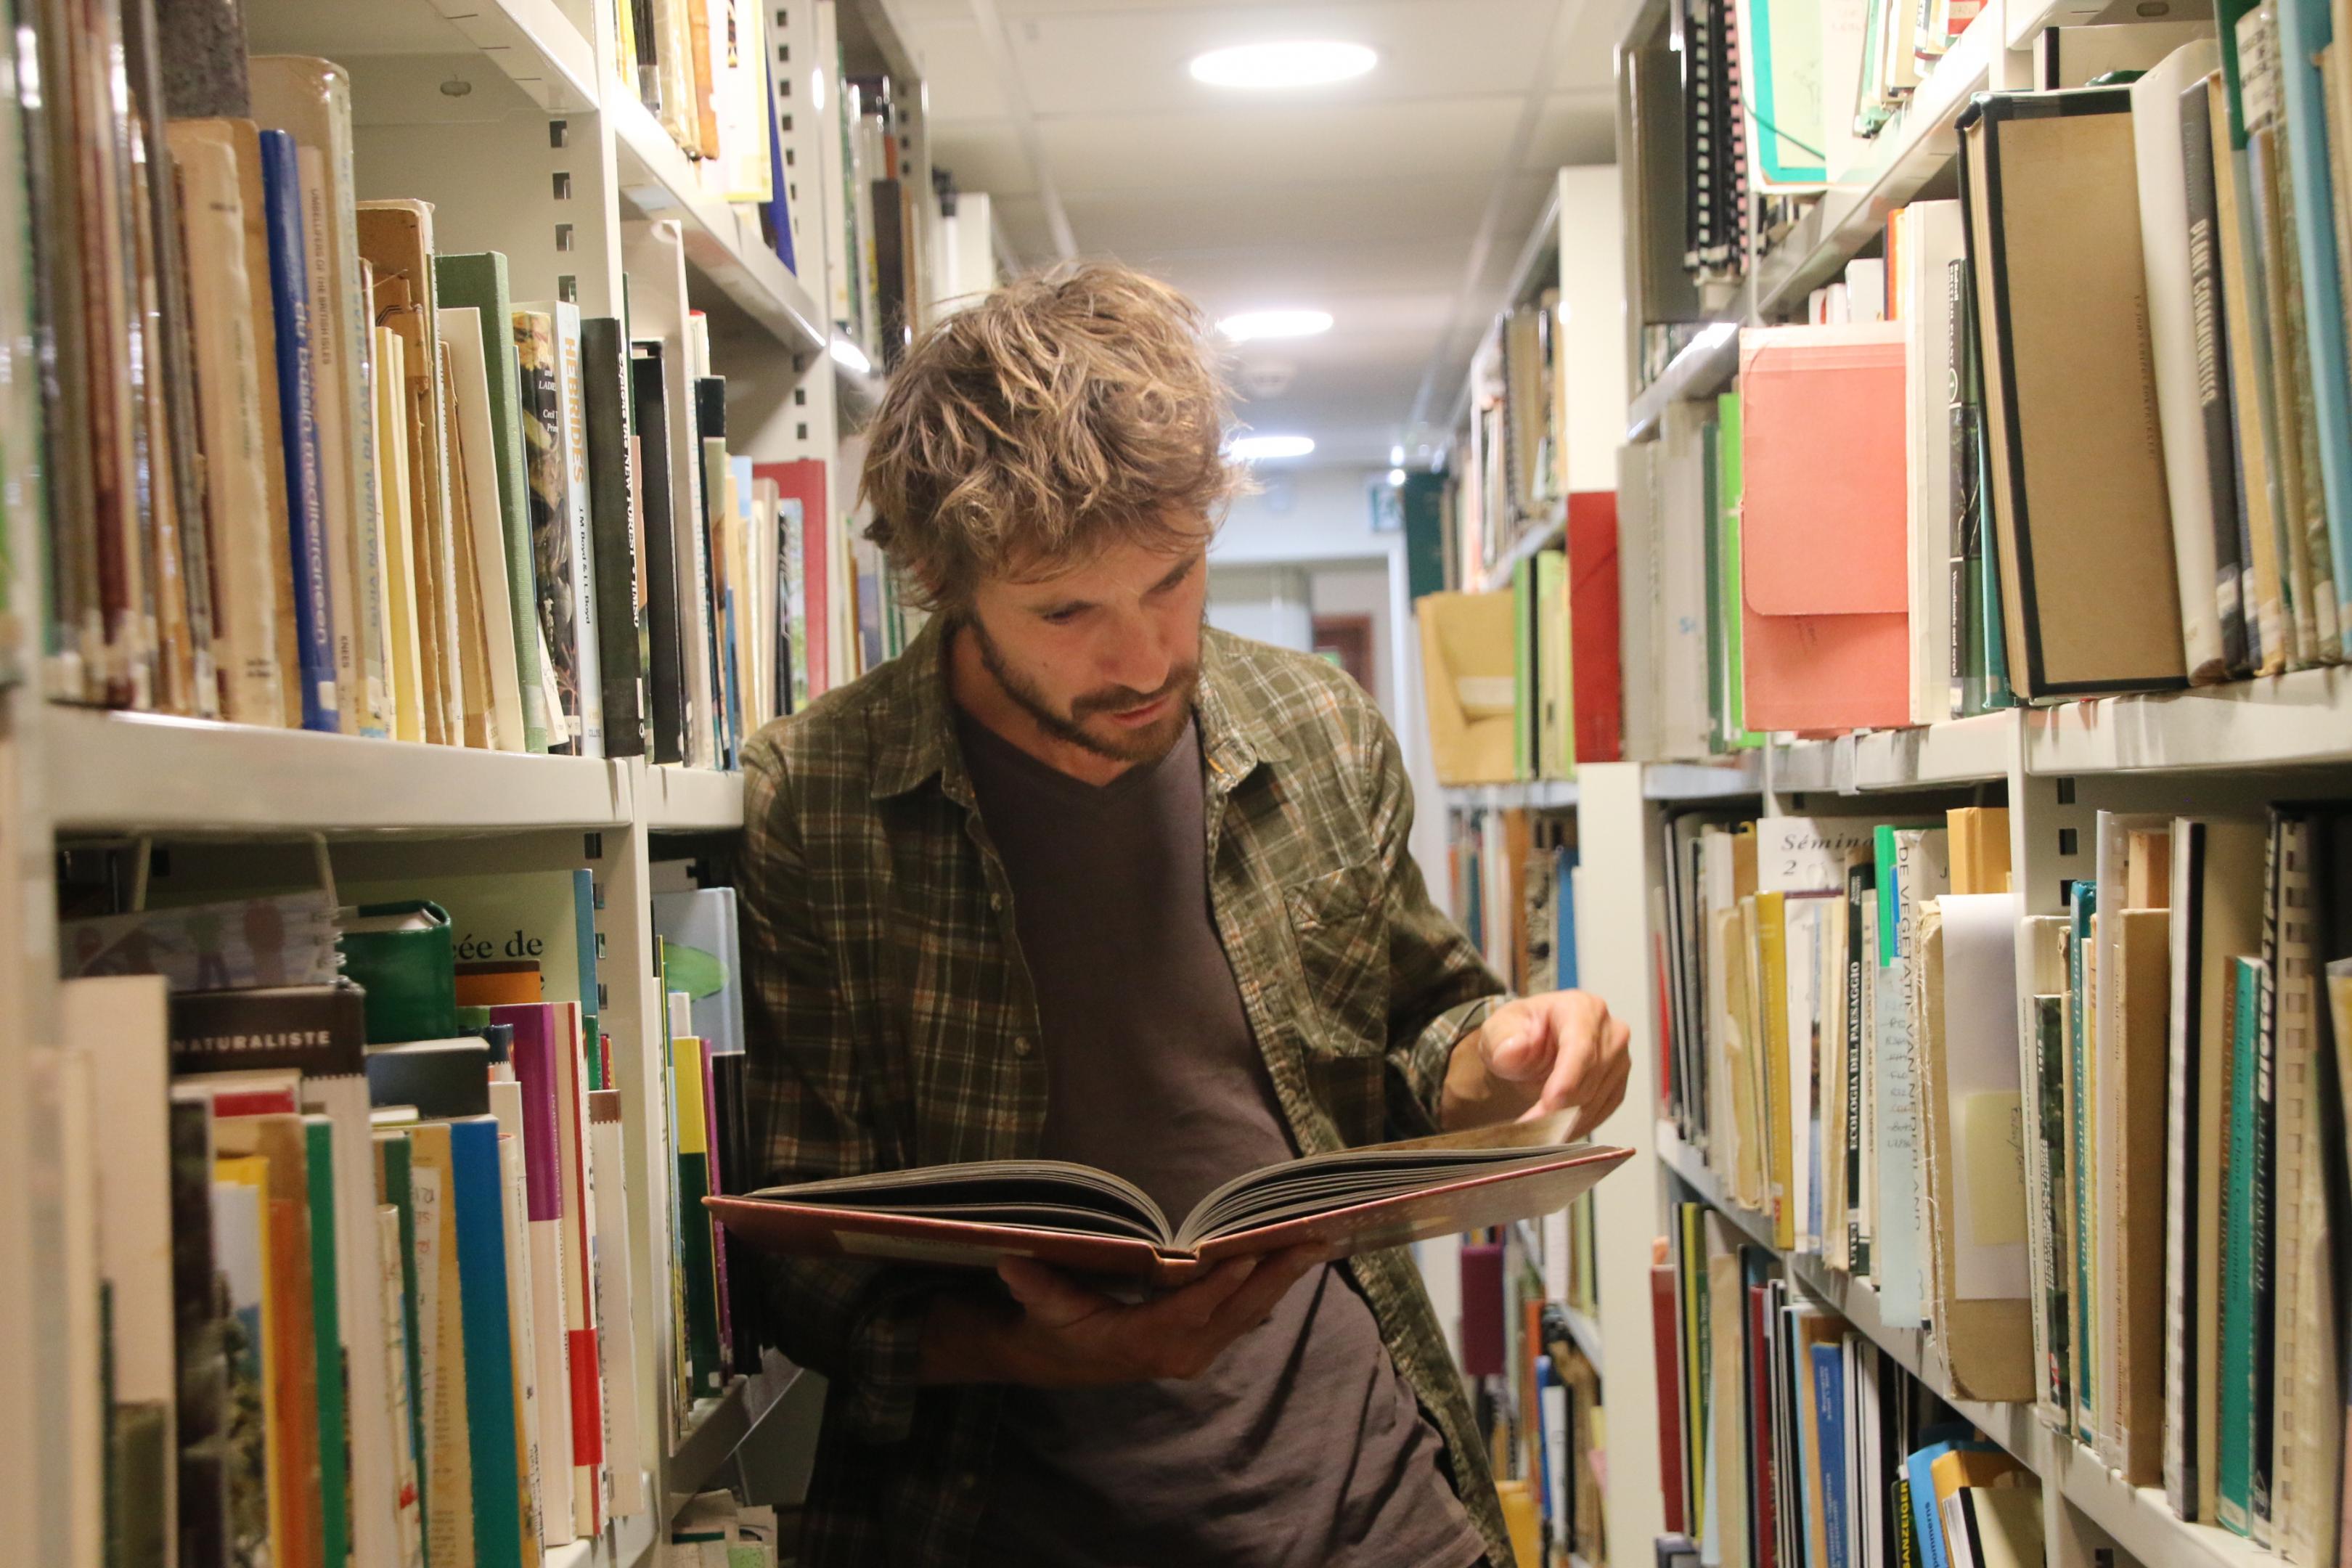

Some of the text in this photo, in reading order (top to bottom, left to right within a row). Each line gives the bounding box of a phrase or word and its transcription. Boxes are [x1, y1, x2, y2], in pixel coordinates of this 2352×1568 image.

[2189, 218, 2209, 277] PLANT
[316, 259, 324, 272] OF
[317, 277, 326, 293] THE
[318, 297, 329, 335] BRITISH
[321, 338, 331, 364] ISLES
[2192, 274, 2218, 407] COMMUNITIES
[297, 347, 313, 430] bassin
[565, 338, 585, 483] HEBRIDES
[624, 454, 632, 495] NEW
[340, 636, 349, 669] KNEES
[1898, 847, 1910, 877] DE
[505, 929, 544, 957] de
[172, 1030, 331, 1052] NATURALISTE
[1850, 962, 1860, 1150] ECOLOGIA DEL PAESAGGIO
[1867, 1050, 1873, 1065] AN
[1900, 1482, 1910, 1568] SANZEIGER
